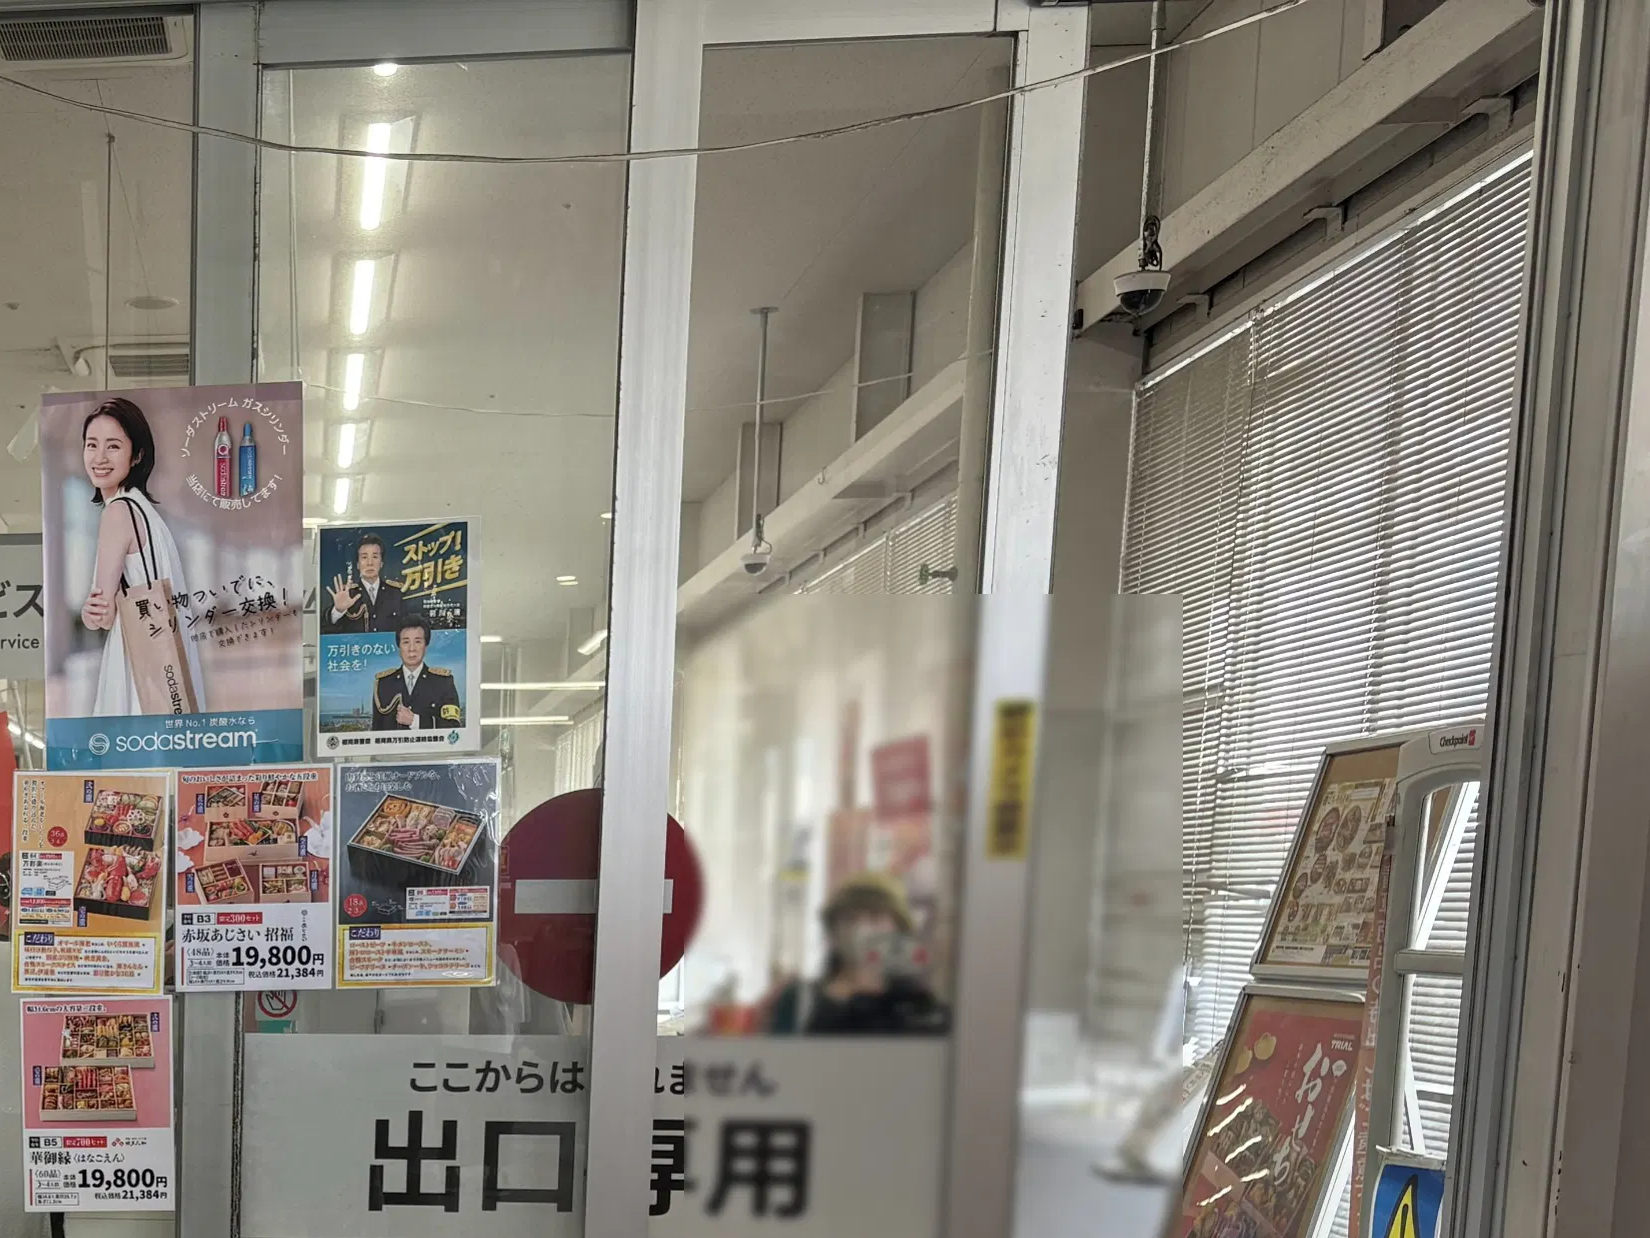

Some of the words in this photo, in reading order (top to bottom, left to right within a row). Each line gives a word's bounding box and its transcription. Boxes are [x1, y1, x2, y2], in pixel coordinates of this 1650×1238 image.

[181, 397, 238, 458] ソーダストリーム
[241, 398, 290, 456] ガスシリンダー
[402, 530, 462, 564] ストップ!
[400, 555, 464, 593] 万引き
[327, 643, 396, 658] 万引きのない
[327, 658, 368, 673] 社会を!
[185, 718, 207, 728] No.1
[115, 729, 258, 752] sodastream
[197, 915, 211, 923] B3
[182, 927, 261, 943] 赤坂あじさい
[264, 926, 294, 942] 招福
[231, 945, 325, 969] 19,800円
[1331, 1040, 1353, 1051] TRIAL
[44, 1138, 58, 1147] B5
[78, 1168, 168, 1191] 19,800円
